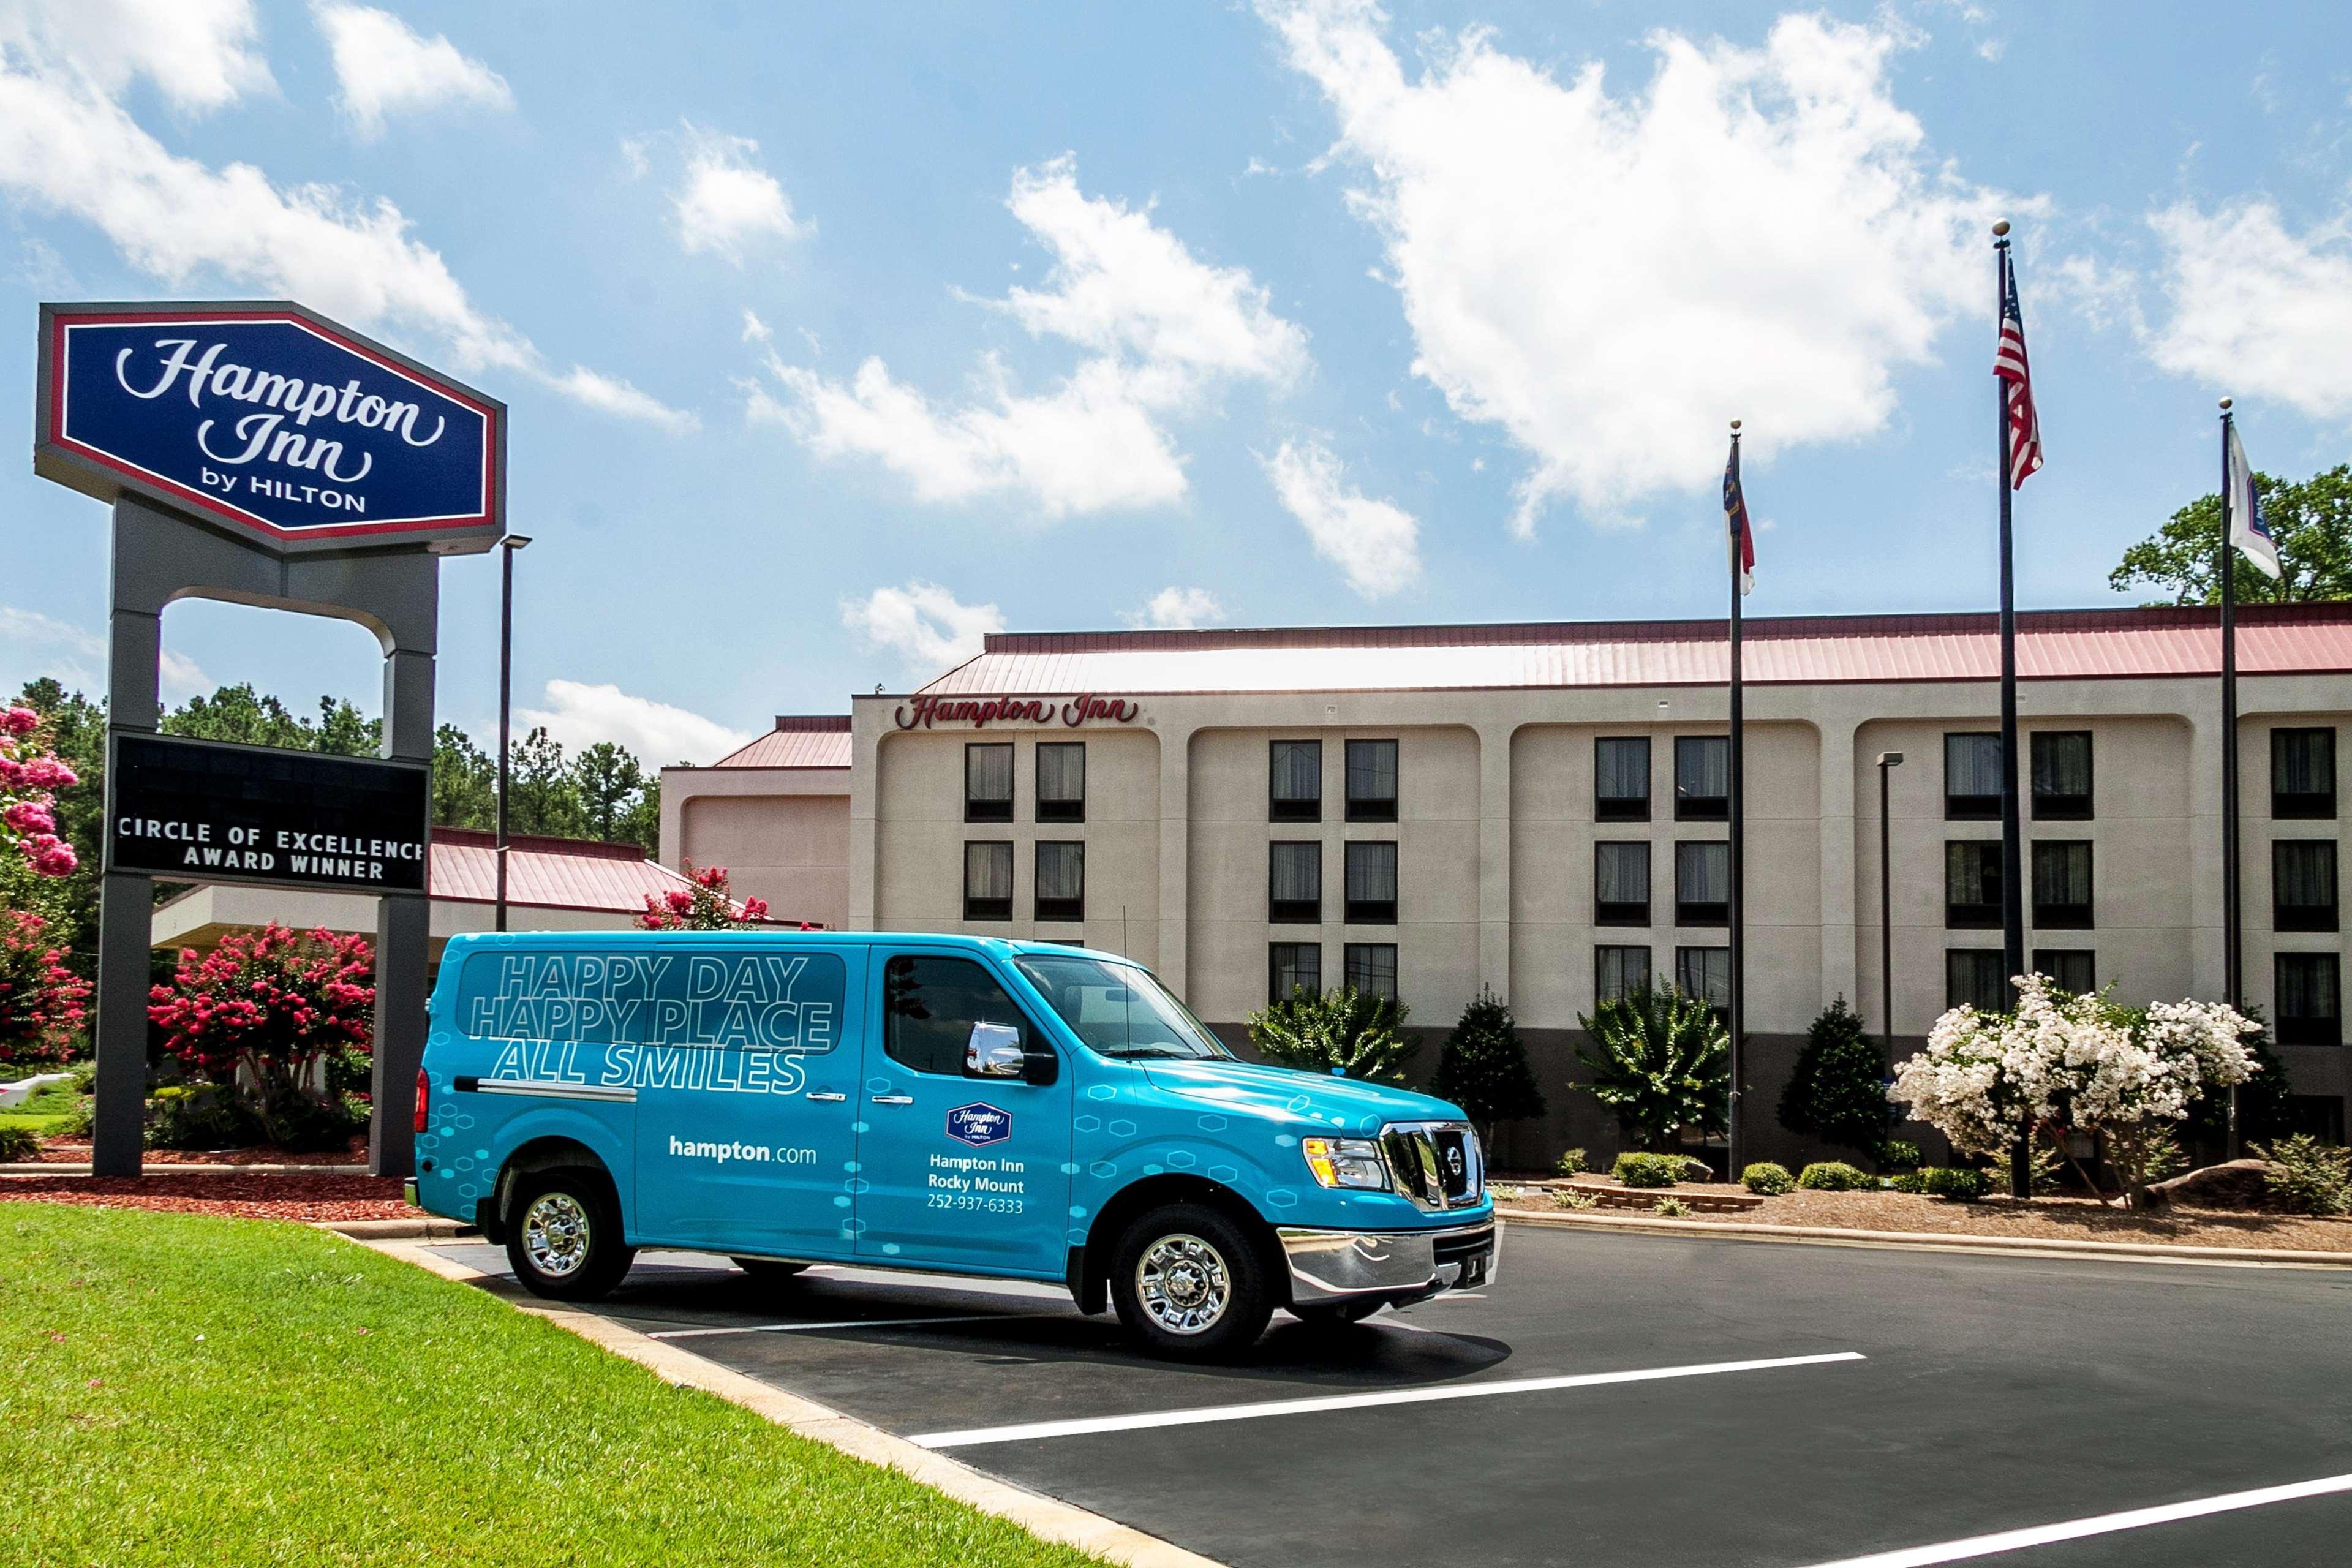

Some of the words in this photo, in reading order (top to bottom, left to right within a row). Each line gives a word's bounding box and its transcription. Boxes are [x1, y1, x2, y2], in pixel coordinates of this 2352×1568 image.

[116, 339, 445, 447] Hampton
[198, 413, 372, 483] Inn
[202, 467, 238, 492] by
[251, 476, 366, 513] HILTON
[895, 695, 1055, 730] Hampton
[1062, 693, 1139, 728] Inn
[119, 817, 211, 842] CIRCLE
[228, 826, 260, 845] OF
[184, 846, 275, 870] AWARD
[291, 855, 383, 880] WINNER
[499, 956, 673, 1001] HAPPY
[687, 957, 810, 1003] DAY
[469, 997, 640, 1044] HAPPY
[653, 1000, 833, 1050] PLACE
[491, 1039, 586, 1084] ALL
[601, 1043, 806, 1095] SMILES
[954, 1110, 1005, 1125] Hampton
[964, 1121, 992, 1134] Inn
[669, 1136, 816, 1164] hampton.com
[930, 1154, 997, 1172] Hampton
[1001, 1158, 1025, 1173] Inn
[929, 1174, 970, 1193] Rocky
[974, 1177, 1024, 1194] Mount
[927, 1194, 1023, 1214] 252-937-6333
